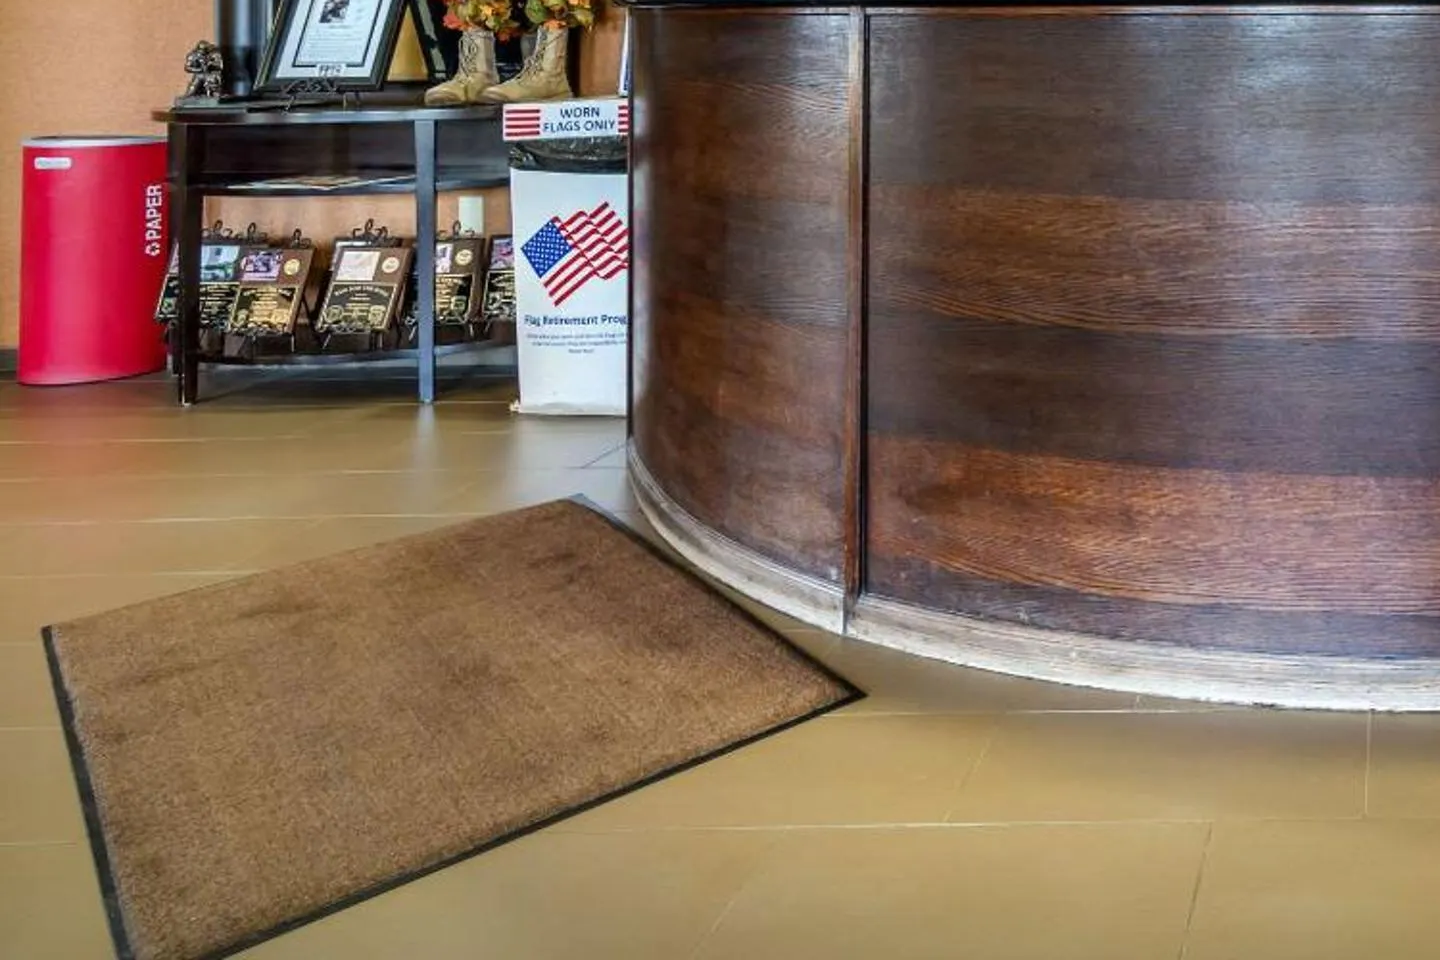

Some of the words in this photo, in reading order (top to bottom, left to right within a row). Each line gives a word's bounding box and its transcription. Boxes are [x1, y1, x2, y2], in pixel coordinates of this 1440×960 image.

[560, 106, 601, 120] WORN
[543, 120, 581, 134] FLAGS
[583, 119, 616, 132] ONLY
[144, 183, 163, 241] PAPER
[524, 314, 541, 327] Flag
[542, 314, 599, 326] Retirement
